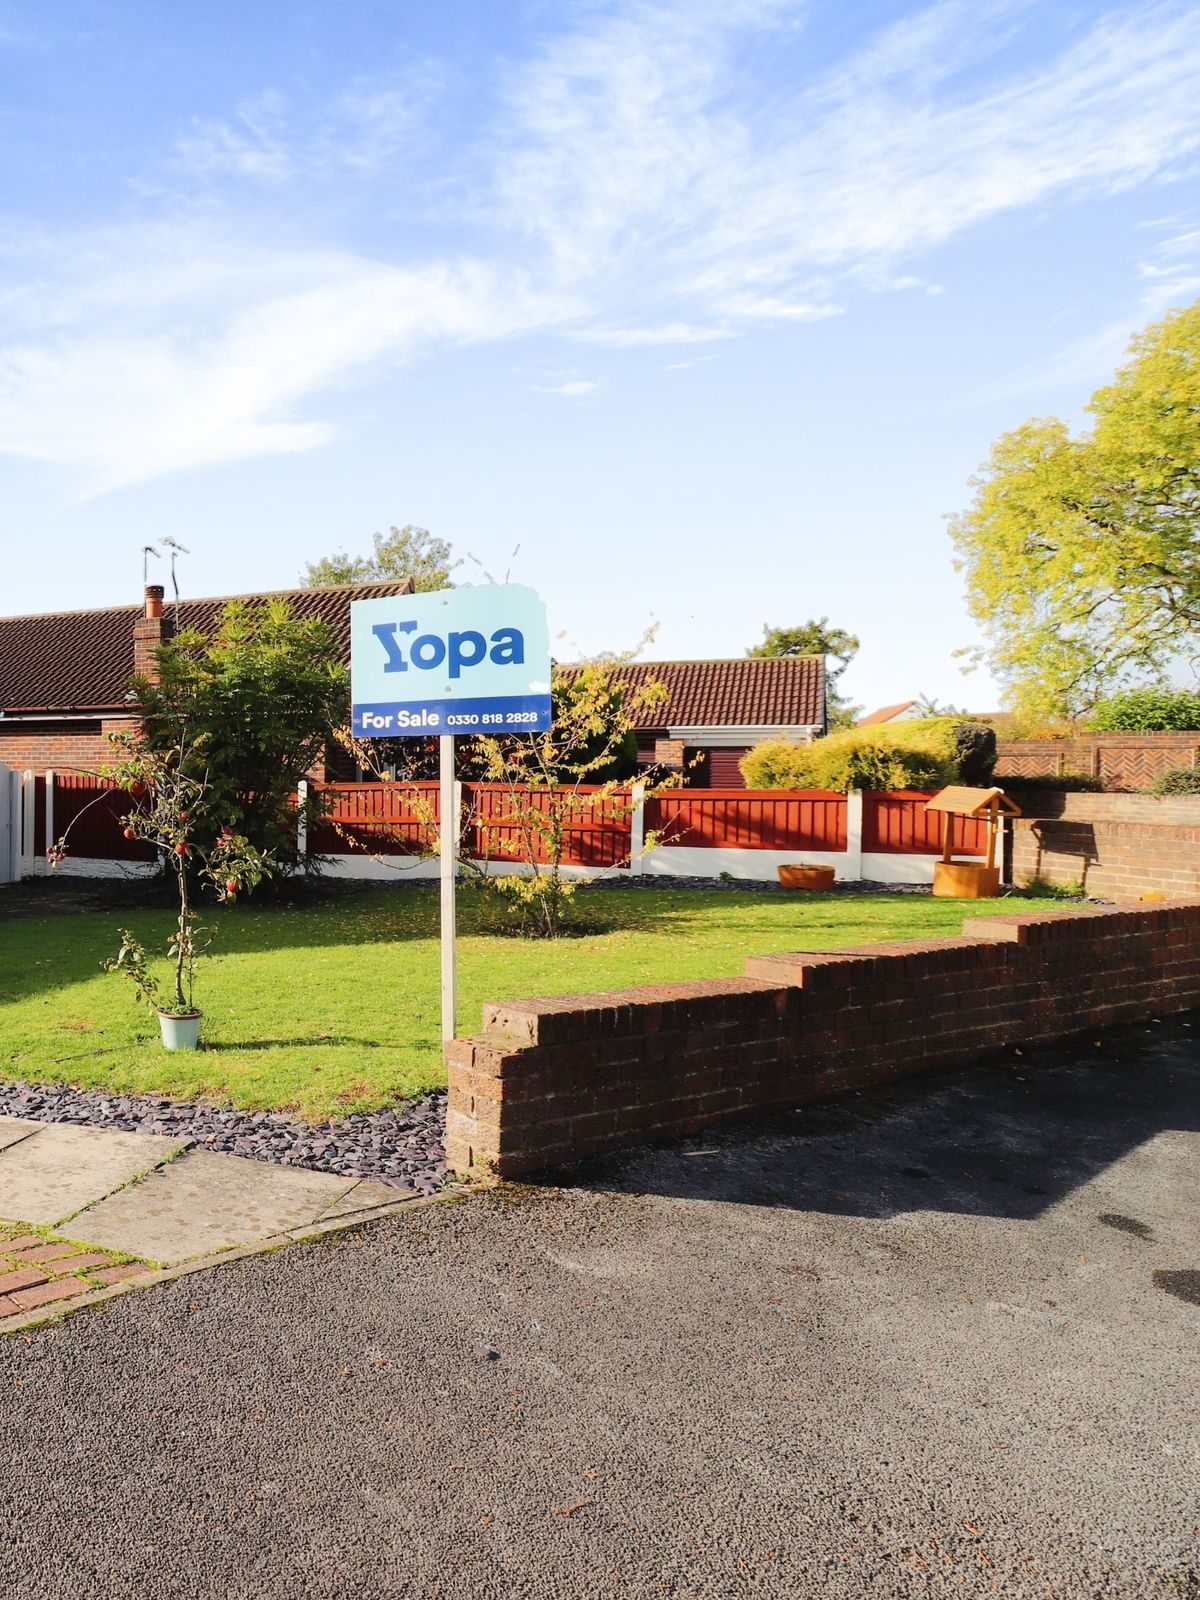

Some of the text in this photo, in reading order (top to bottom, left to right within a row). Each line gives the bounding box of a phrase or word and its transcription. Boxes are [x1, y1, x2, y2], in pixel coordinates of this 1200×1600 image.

[372, 620, 525, 679] Yopa
[362, 709, 538, 729] For Sale 0330 818 2828
